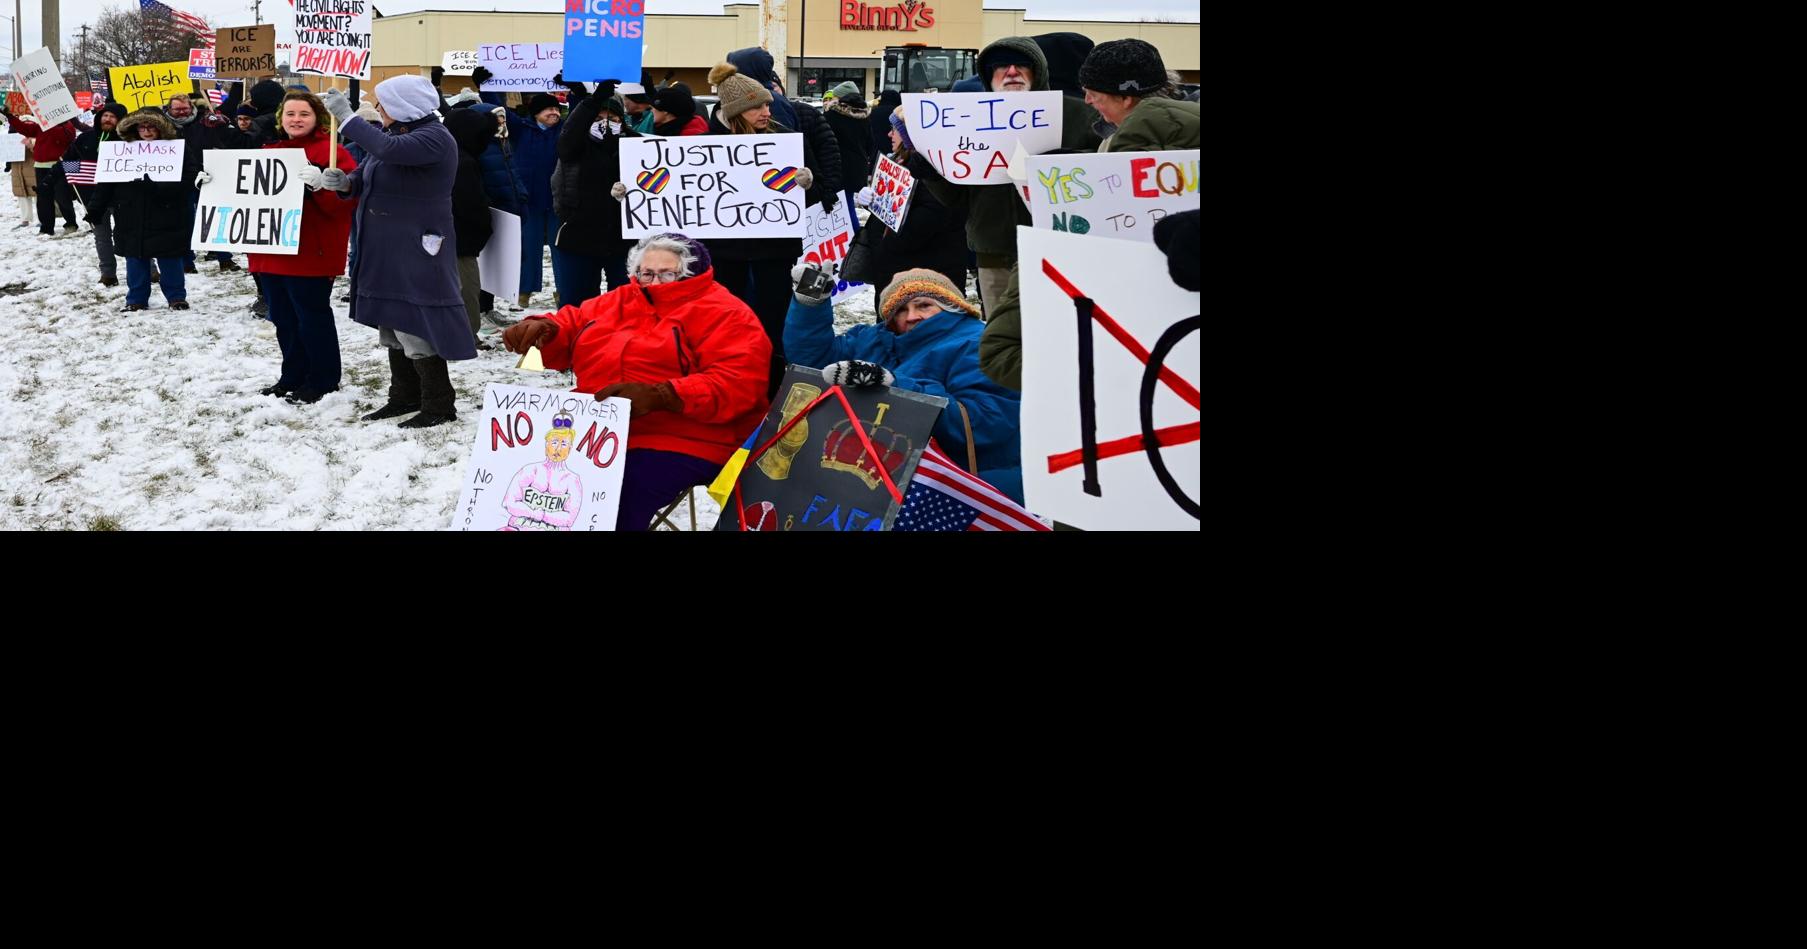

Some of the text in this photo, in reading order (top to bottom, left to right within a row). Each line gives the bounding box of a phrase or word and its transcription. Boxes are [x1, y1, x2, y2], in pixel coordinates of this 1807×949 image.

[295, 0, 365, 15] THE CIVIL RIGHTS
[566, 0, 645, 16] MICRO
[296, 14, 352, 32] MOVEMENT?
[567, 18, 642, 38] PENIS
[230, 27, 259, 42] ICE
[295, 30, 371, 49] YOU ARE DOING IT
[232, 45, 253, 54] ARE
[482, 45, 524, 61] ICE
[216, 53, 276, 74] TERRORISTS
[295, 45, 370, 77] RIGHT NOW!
[508, 60, 538, 69] and
[123, 69, 181, 90] Abolish
[138, 143, 177, 155] MASK
[957, 136, 990, 151] the
[641, 138, 777, 170] JUSTICE
[103, 159, 174, 173] ICEstapo
[236, 158, 288, 196] END
[680, 171, 739, 192] FOR
[1037, 157, 1201, 204] YES TO EQU
[624, 189, 801, 230] RENEE GOOD
[200, 205, 301, 247] VIOLENCE
[1052, 211, 1091, 235] NO
[491, 411, 533, 452] NO
[576, 420, 619, 468] NO
[473, 468, 493, 484] NO
[524, 489, 566, 511] EPSTEIN
[592, 491, 606, 503] NO
